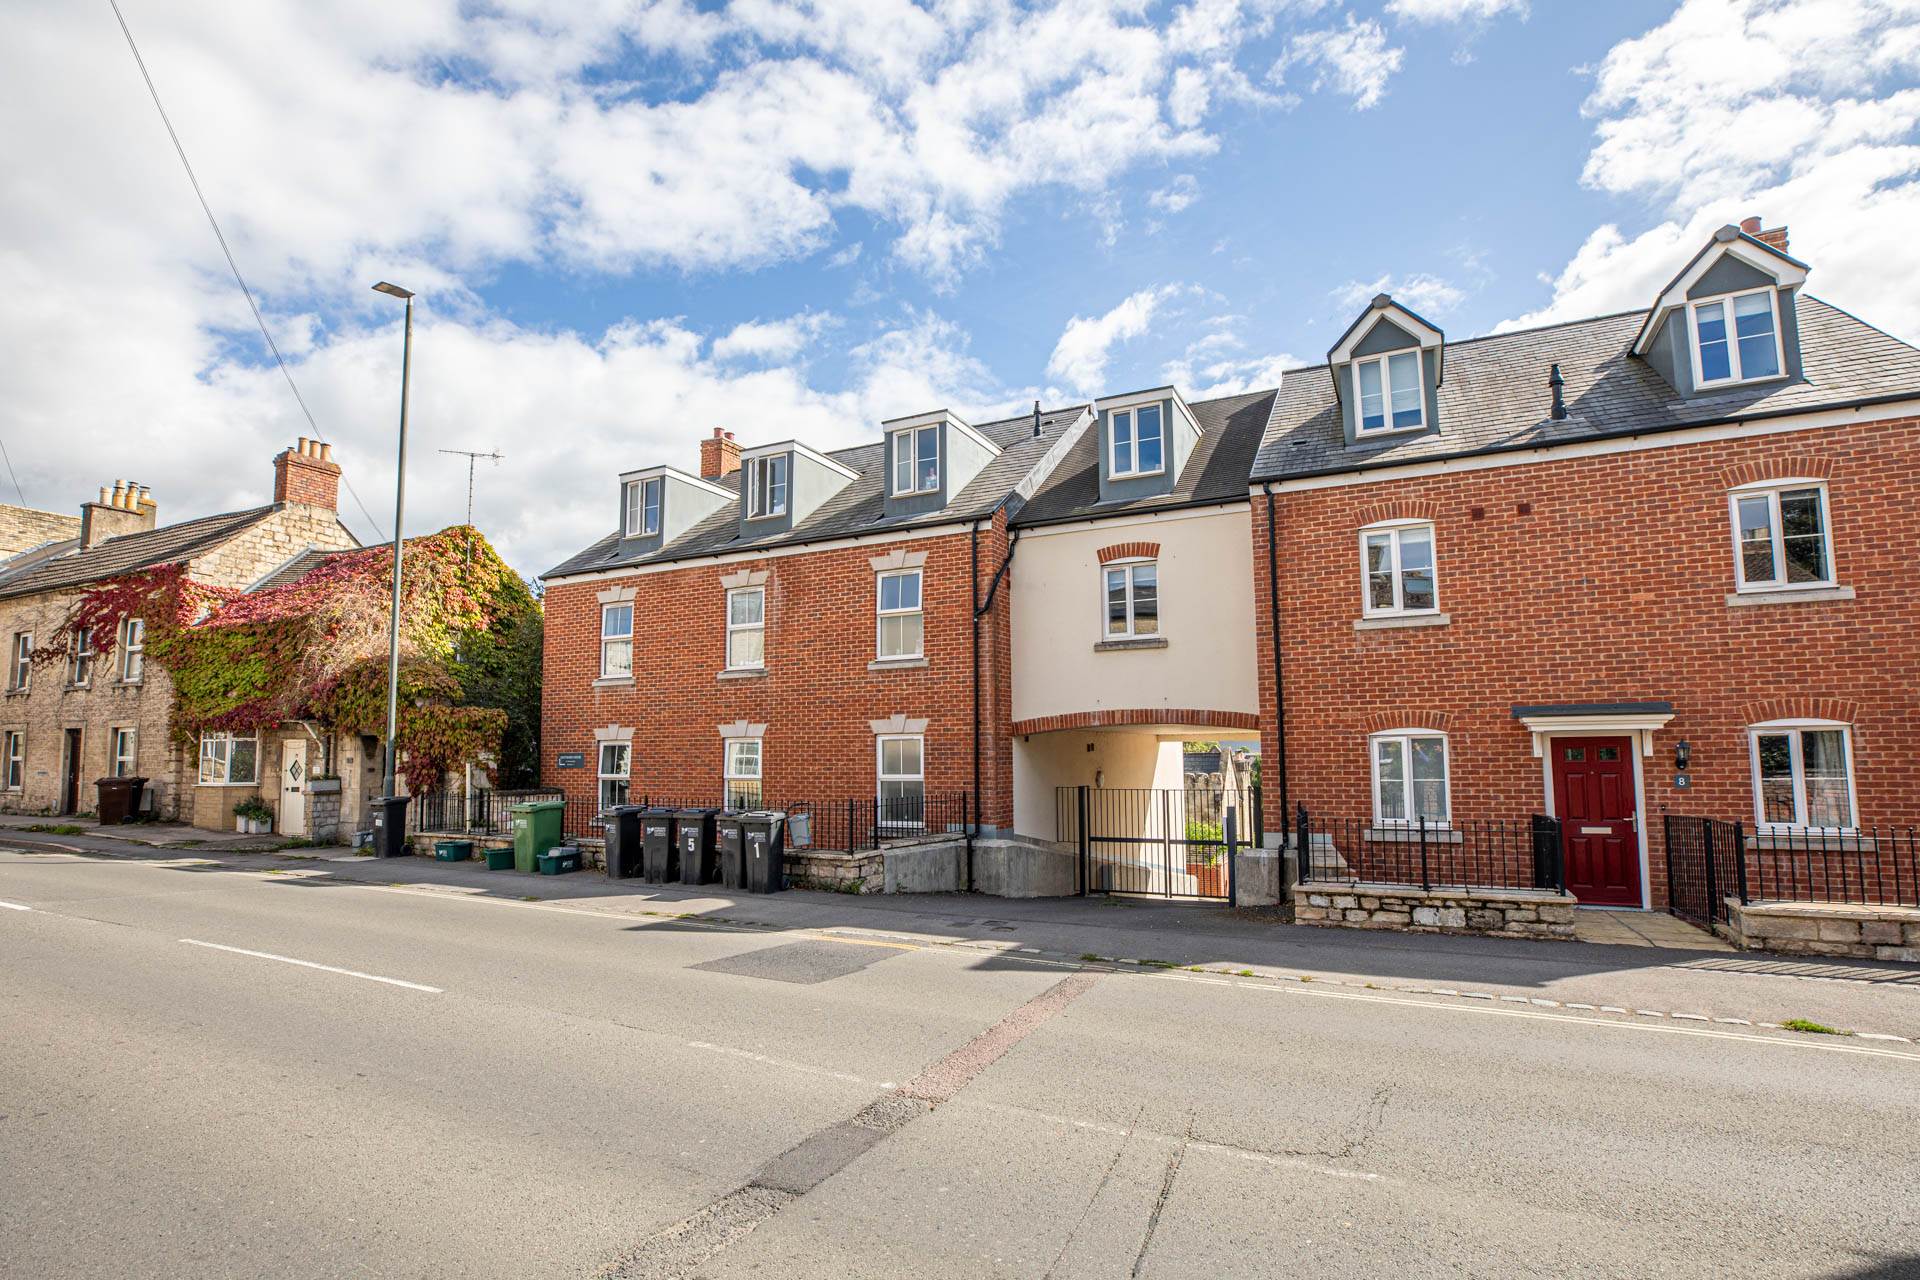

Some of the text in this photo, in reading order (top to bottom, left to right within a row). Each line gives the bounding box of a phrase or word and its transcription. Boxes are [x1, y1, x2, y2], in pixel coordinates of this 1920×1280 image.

[1678, 777, 1685, 786] 8
[687, 838, 695, 852] 5
[753, 842, 760, 858] 1
